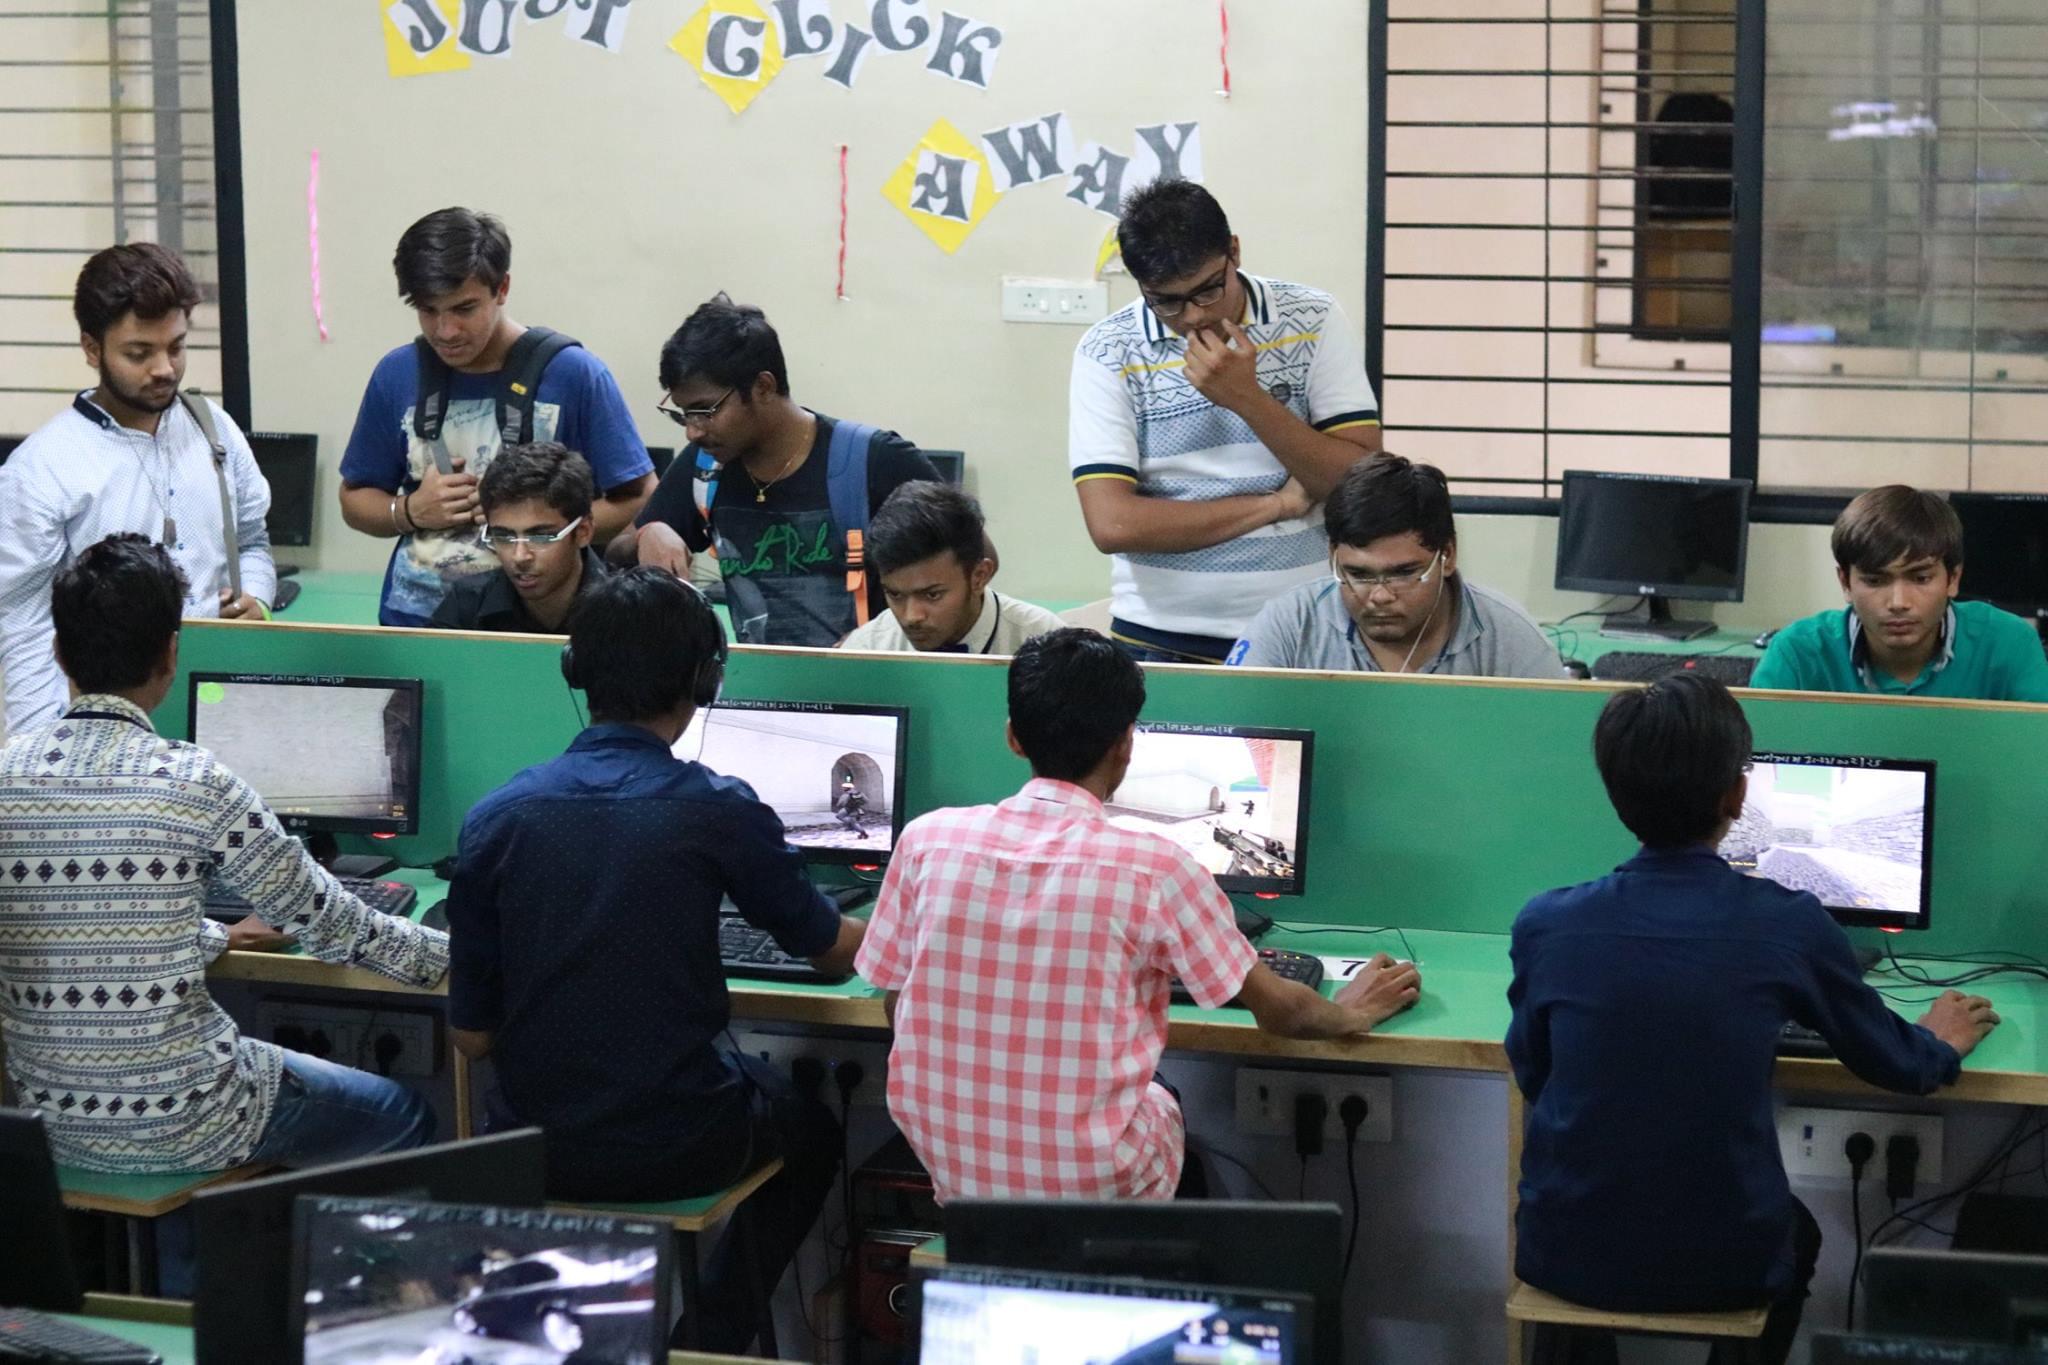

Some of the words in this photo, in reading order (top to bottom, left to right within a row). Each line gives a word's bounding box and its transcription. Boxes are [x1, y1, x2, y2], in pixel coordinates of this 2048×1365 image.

[706, 0, 1002, 88] CLICK
[911, 112, 1198, 222] AWAY
[1341, 960, 1367, 976] 7
